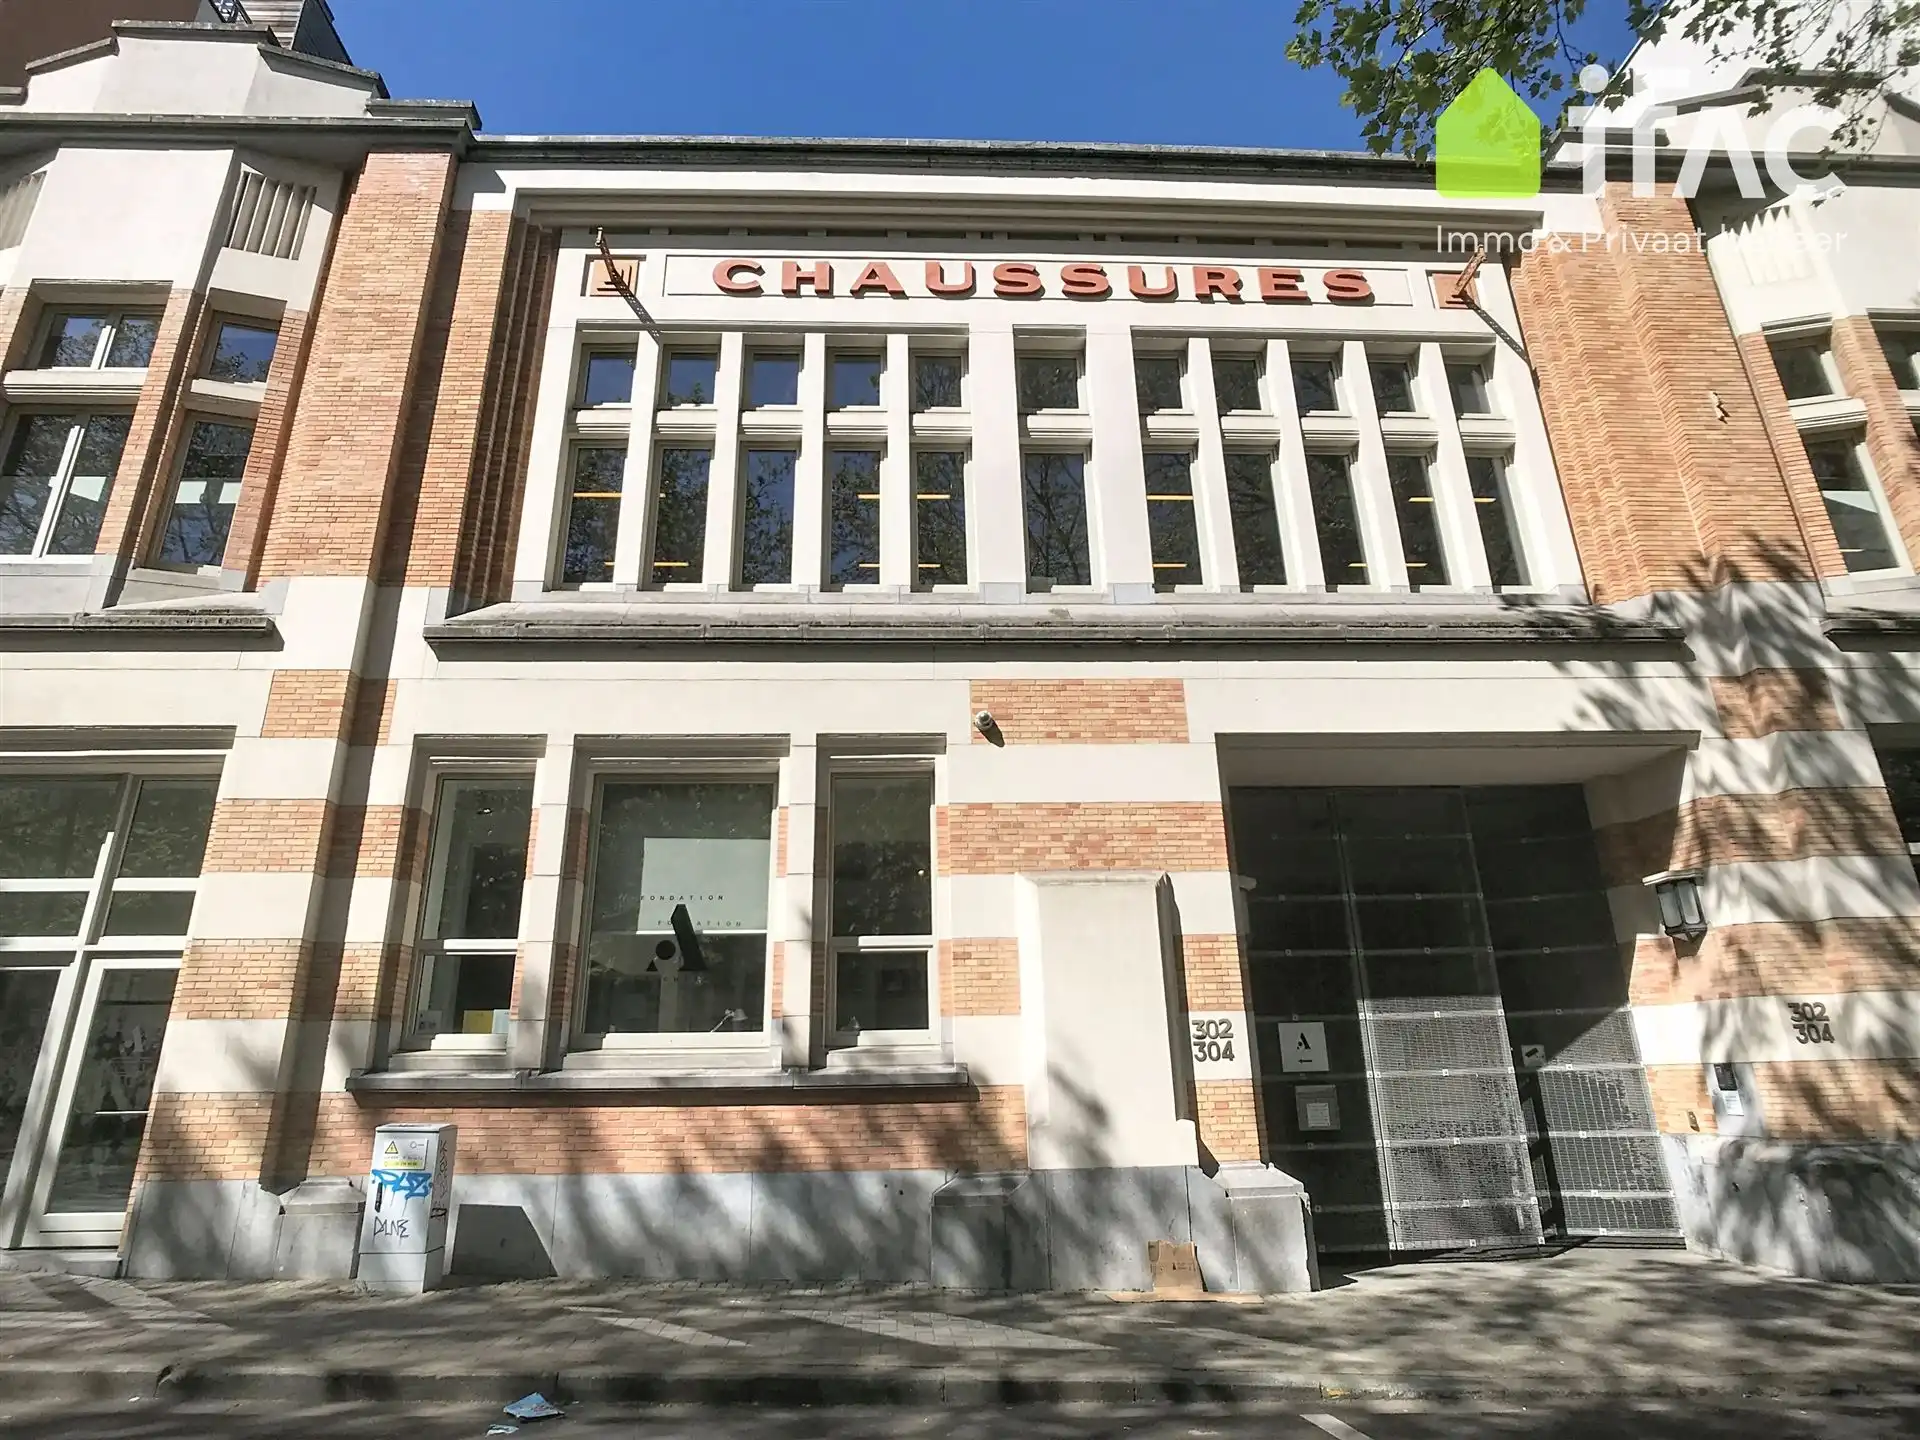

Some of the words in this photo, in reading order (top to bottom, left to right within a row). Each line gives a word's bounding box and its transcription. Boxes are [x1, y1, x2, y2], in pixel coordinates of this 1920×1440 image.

[712, 258, 1373, 302] CHAUSSURES
[1788, 1002, 1830, 1022] 302
[1191, 1018, 1234, 1040] 302
[1792, 1023, 1836, 1044] 304
[1193, 1040, 1235, 1062] 304
